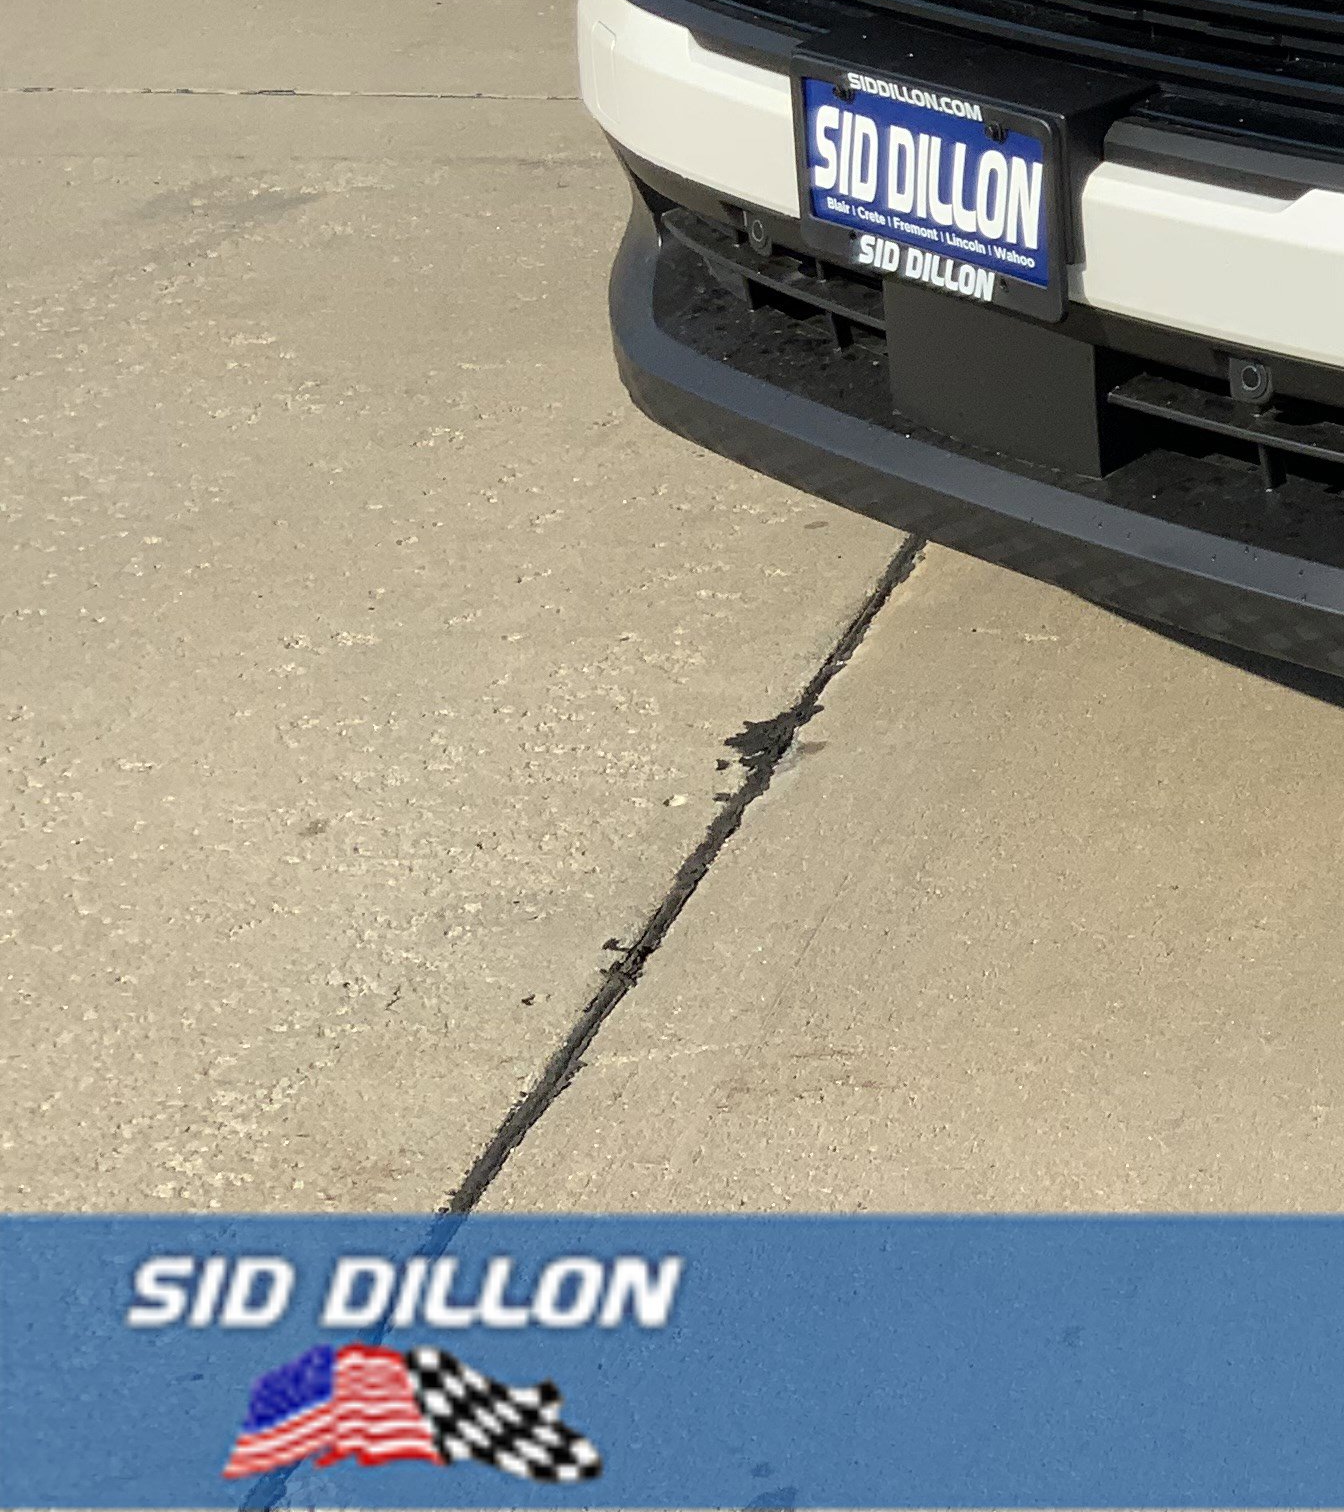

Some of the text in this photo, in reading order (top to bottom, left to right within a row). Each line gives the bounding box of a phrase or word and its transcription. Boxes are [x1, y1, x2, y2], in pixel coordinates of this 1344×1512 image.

[847, 72, 983, 122] SIDDILLON.COM
[813, 104, 1044, 250] SID DILLON
[826, 196, 1036, 269] Blair Crete Fremont Lincoln Wahoo
[858, 234, 996, 302] SID DILLON
